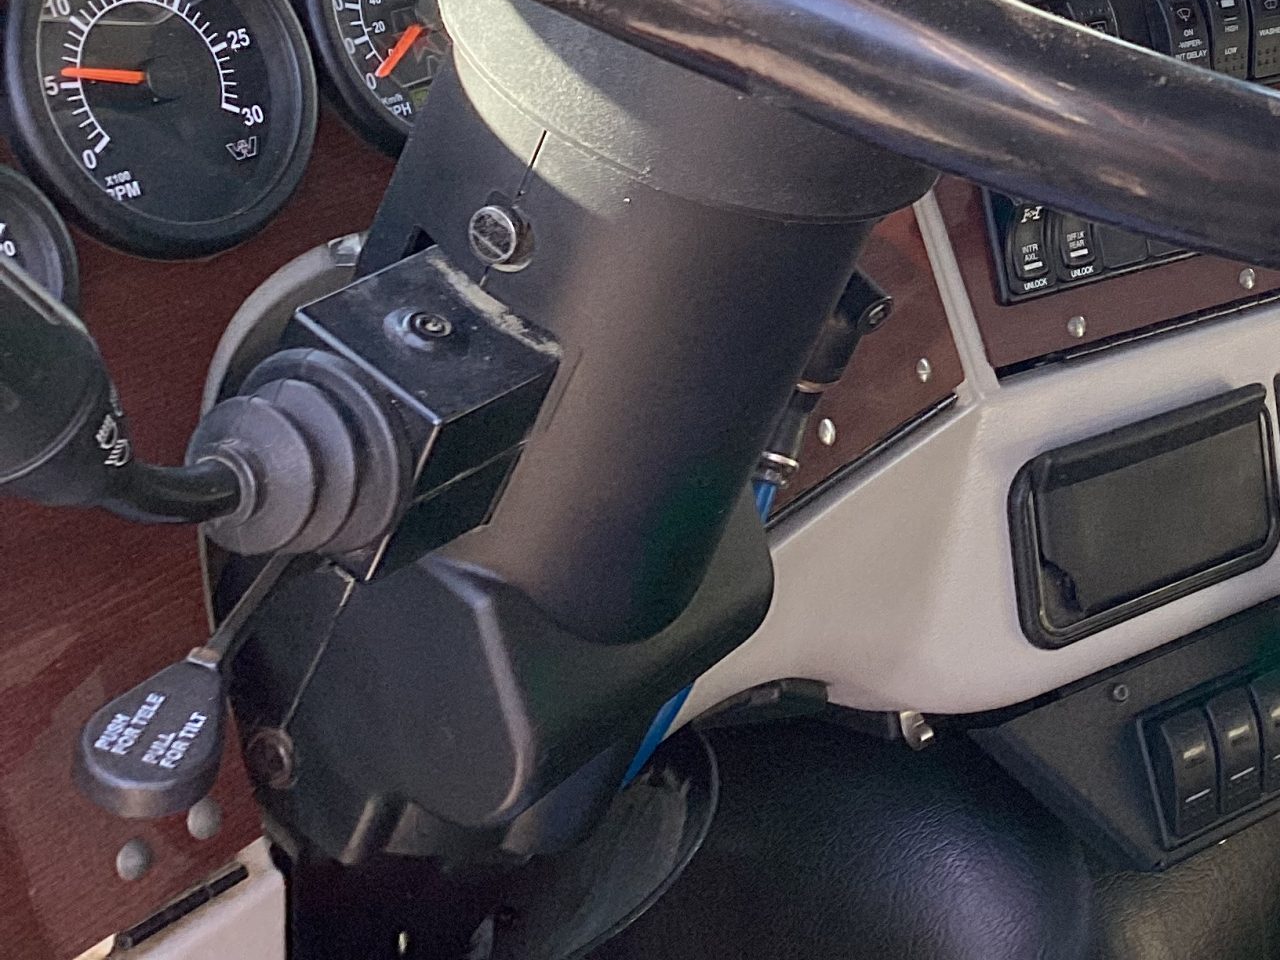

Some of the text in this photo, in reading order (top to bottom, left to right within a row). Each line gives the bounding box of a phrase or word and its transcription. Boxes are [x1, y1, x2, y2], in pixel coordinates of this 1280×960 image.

[371, 20, 386, 34] 20
[227, 28, 251, 50] 25
[44, 75, 59, 96] 5
[241, 104, 264, 127] 30
[82, 149, 97, 170] 0
[1070, 266, 1094, 278] UNLOCK
[1024, 278, 1047, 290] UNLOCK
[111, 727, 142, 754] FOR
[141, 732, 177, 764] PULL
[159, 741, 190, 768] FOR
